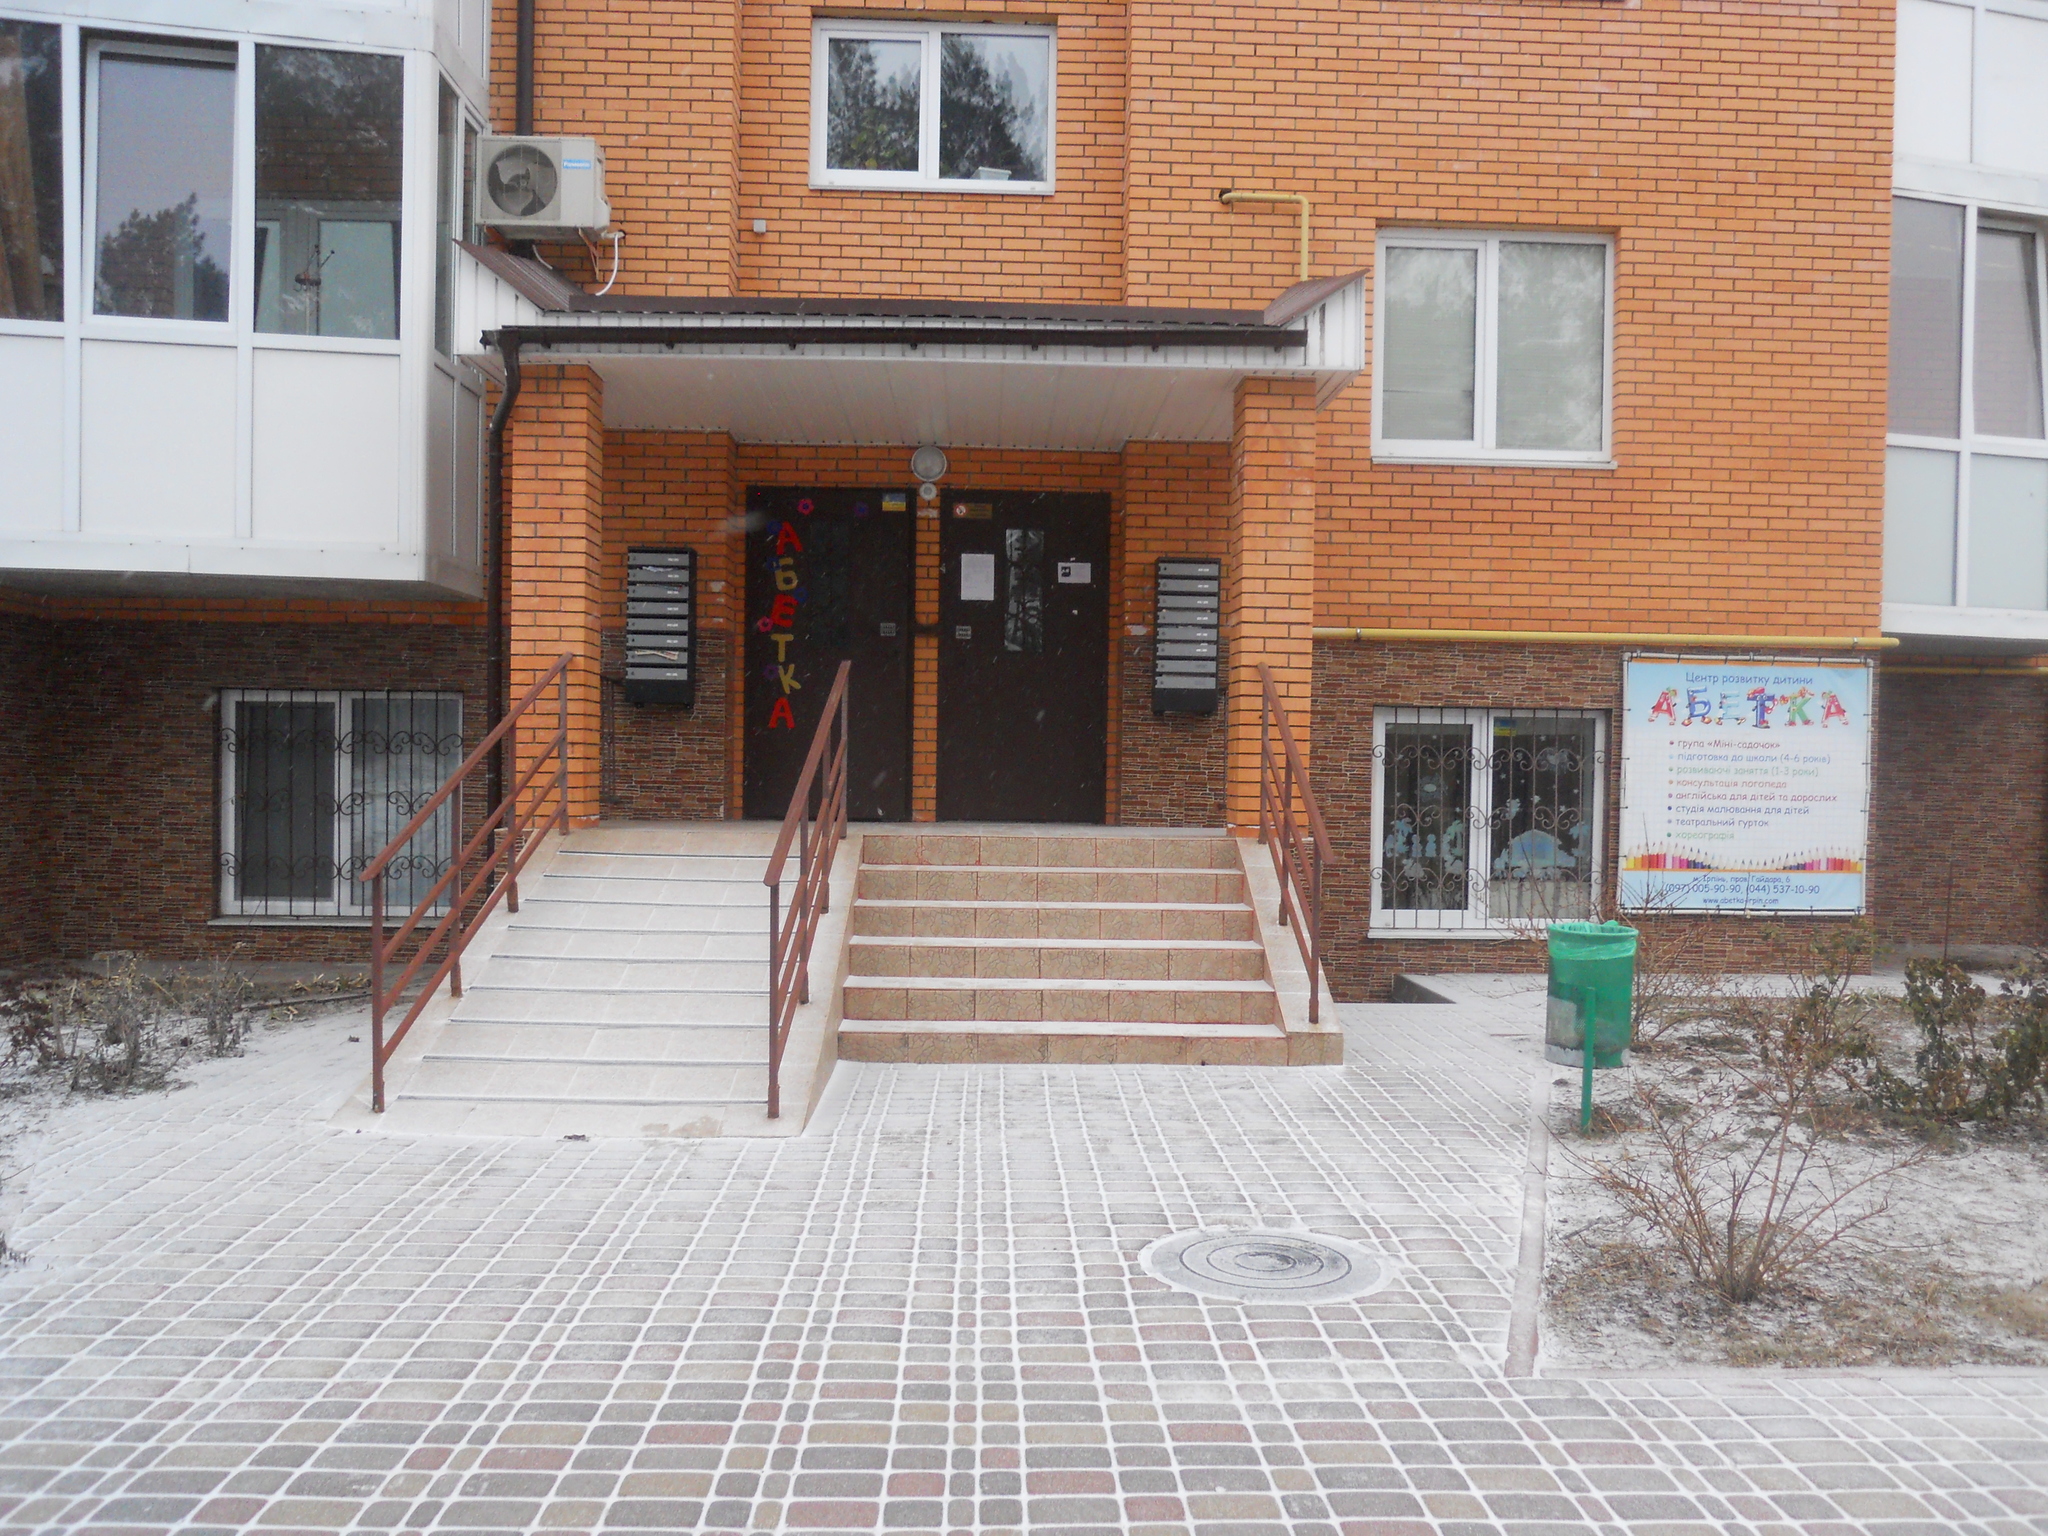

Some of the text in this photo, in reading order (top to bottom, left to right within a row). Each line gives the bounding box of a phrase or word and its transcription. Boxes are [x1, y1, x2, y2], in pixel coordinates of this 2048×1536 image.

[768, 521, 803, 729] АБЕТКА
[1686, 672, 1813, 687] Центр розвитку дитини
[1648, 686, 1850, 729] АБЕТКА
[1677, 740, 1705, 752] група
[1677, 752, 1729, 762] підготовка
[1731, 755, 1743, 763] до
[1780, 754, 1800, 764] (4-6
[1803, 754, 1831, 764] років)
[1676, 765, 1820, 778] розвиваючі заняття (1-3 роки)
[1676, 779, 1787, 789] консультація логопеда
[1676, 792, 1727, 803] англійська
[1750, 792, 1776, 801] дітей
[1790, 795, 1838, 803] дорослих
[1675, 806, 1809, 817] студія малювання для дітей
[1676, 817, 1769, 829] театральний гурток
[1675, 830, 1735, 841] хореографія
[1773, 884, 1820, 894] 537-10-90
